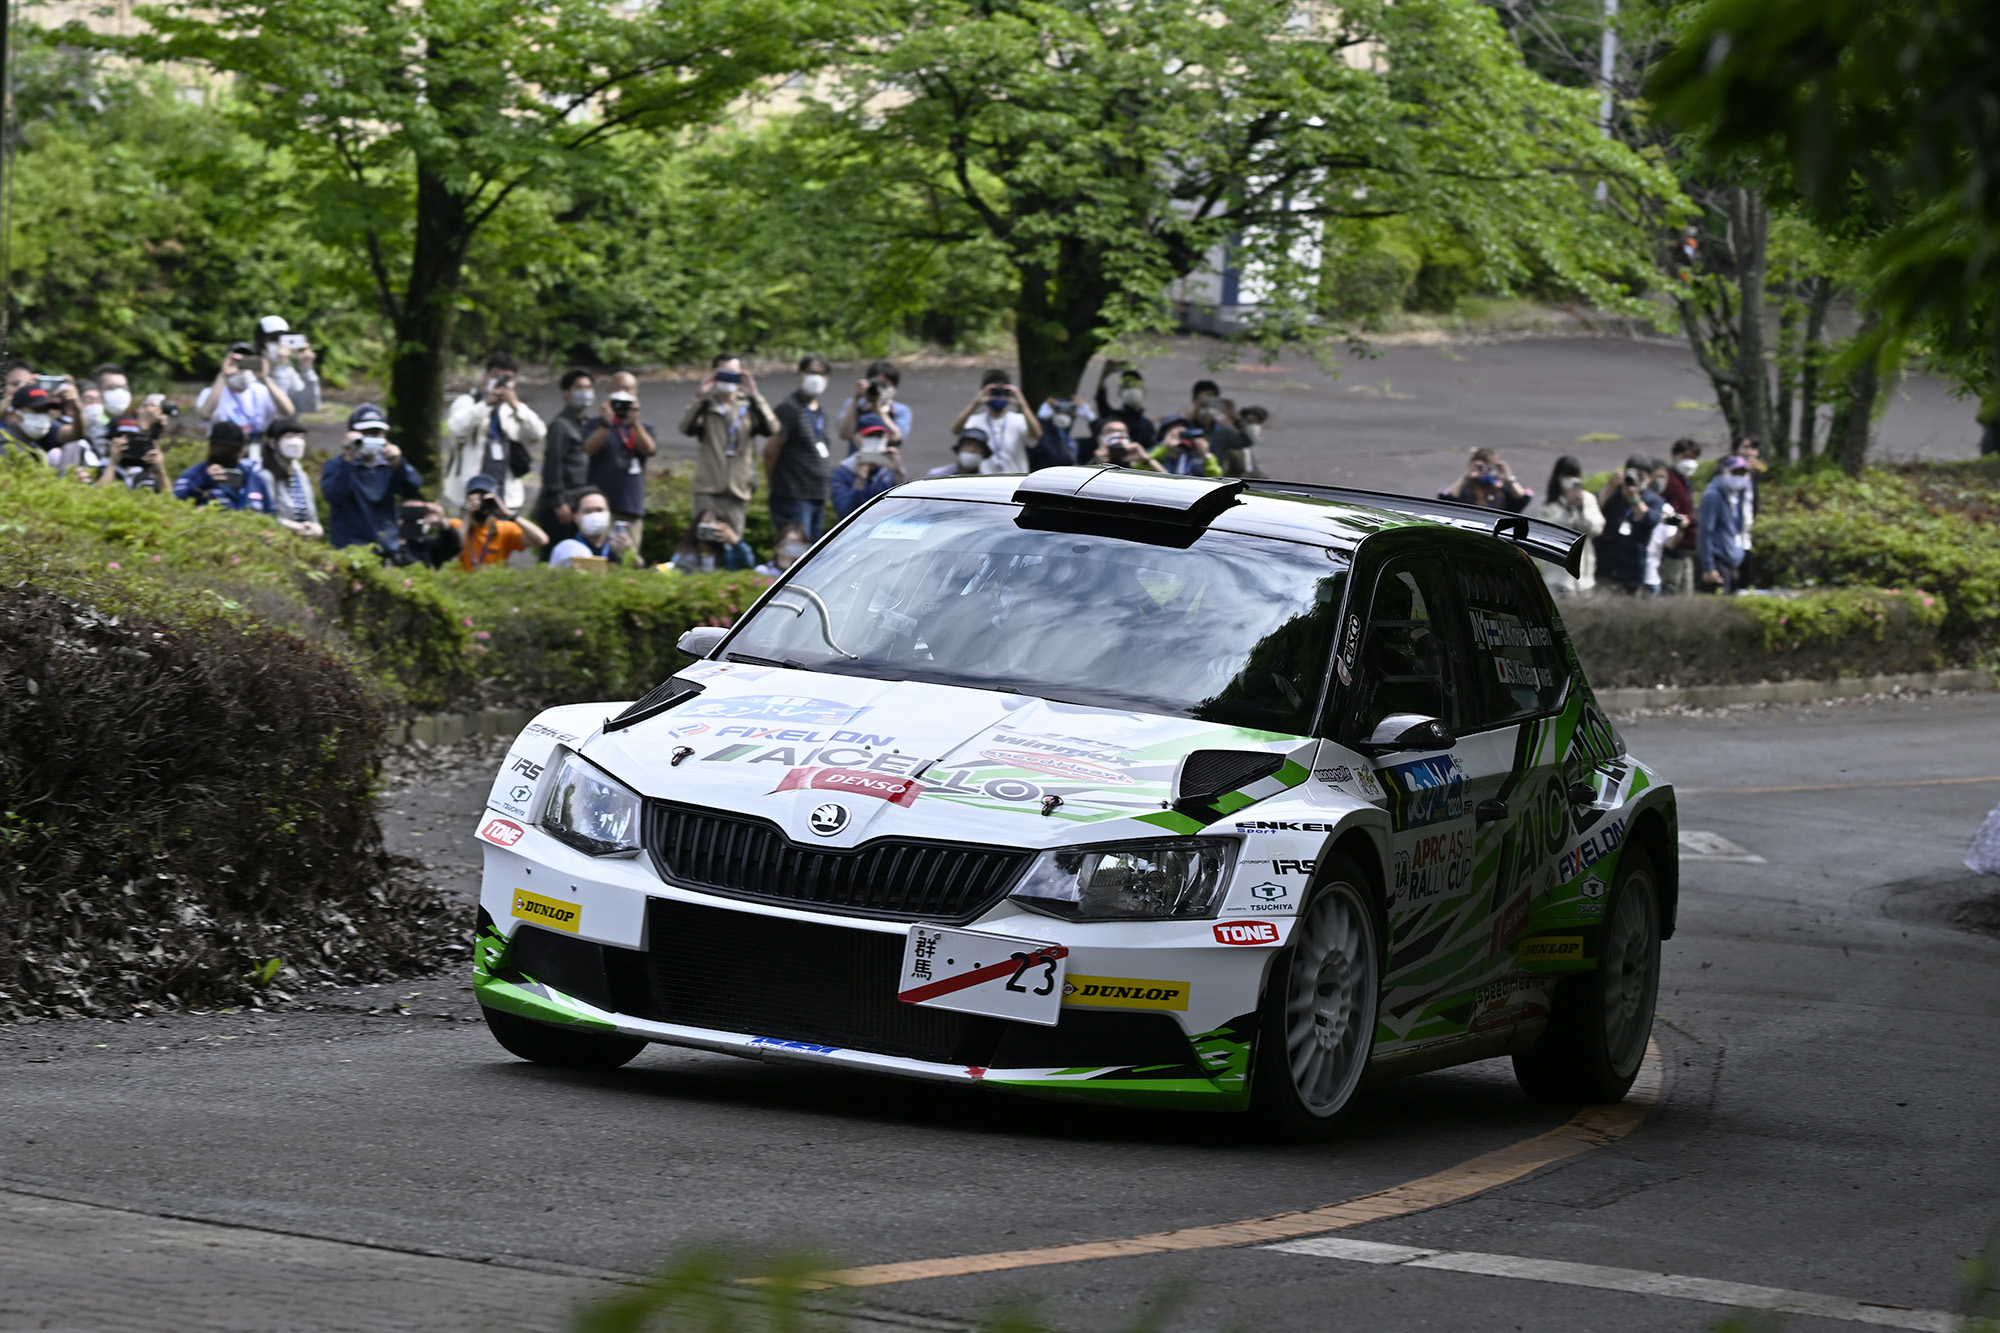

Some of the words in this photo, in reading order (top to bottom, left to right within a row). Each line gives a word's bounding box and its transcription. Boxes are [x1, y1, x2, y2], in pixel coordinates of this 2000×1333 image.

[1343, 614, 1361, 670] CUSCO
[714, 725, 896, 747] FIXELON
[757, 744, 1044, 802] AICELLO
[824, 772, 906, 796] DENSO
[485, 822, 521, 845] TONE
[1235, 821, 1333, 833] ENKEI
[1412, 833, 1446, 871] APRC
[1447, 828, 1474, 861] ASIA
[1558, 817, 1625, 883] FIXELON
[1408, 864, 1448, 901] RALLY
[1448, 858, 1472, 891] CUP
[524, 899, 575, 923] DUNLOP
[1250, 903, 1293, 911] TSUCHIYA
[1217, 924, 1275, 943] TONE
[911, 936, 937, 981] 群馬
[1080, 985, 1179, 1001] DUNLOP
